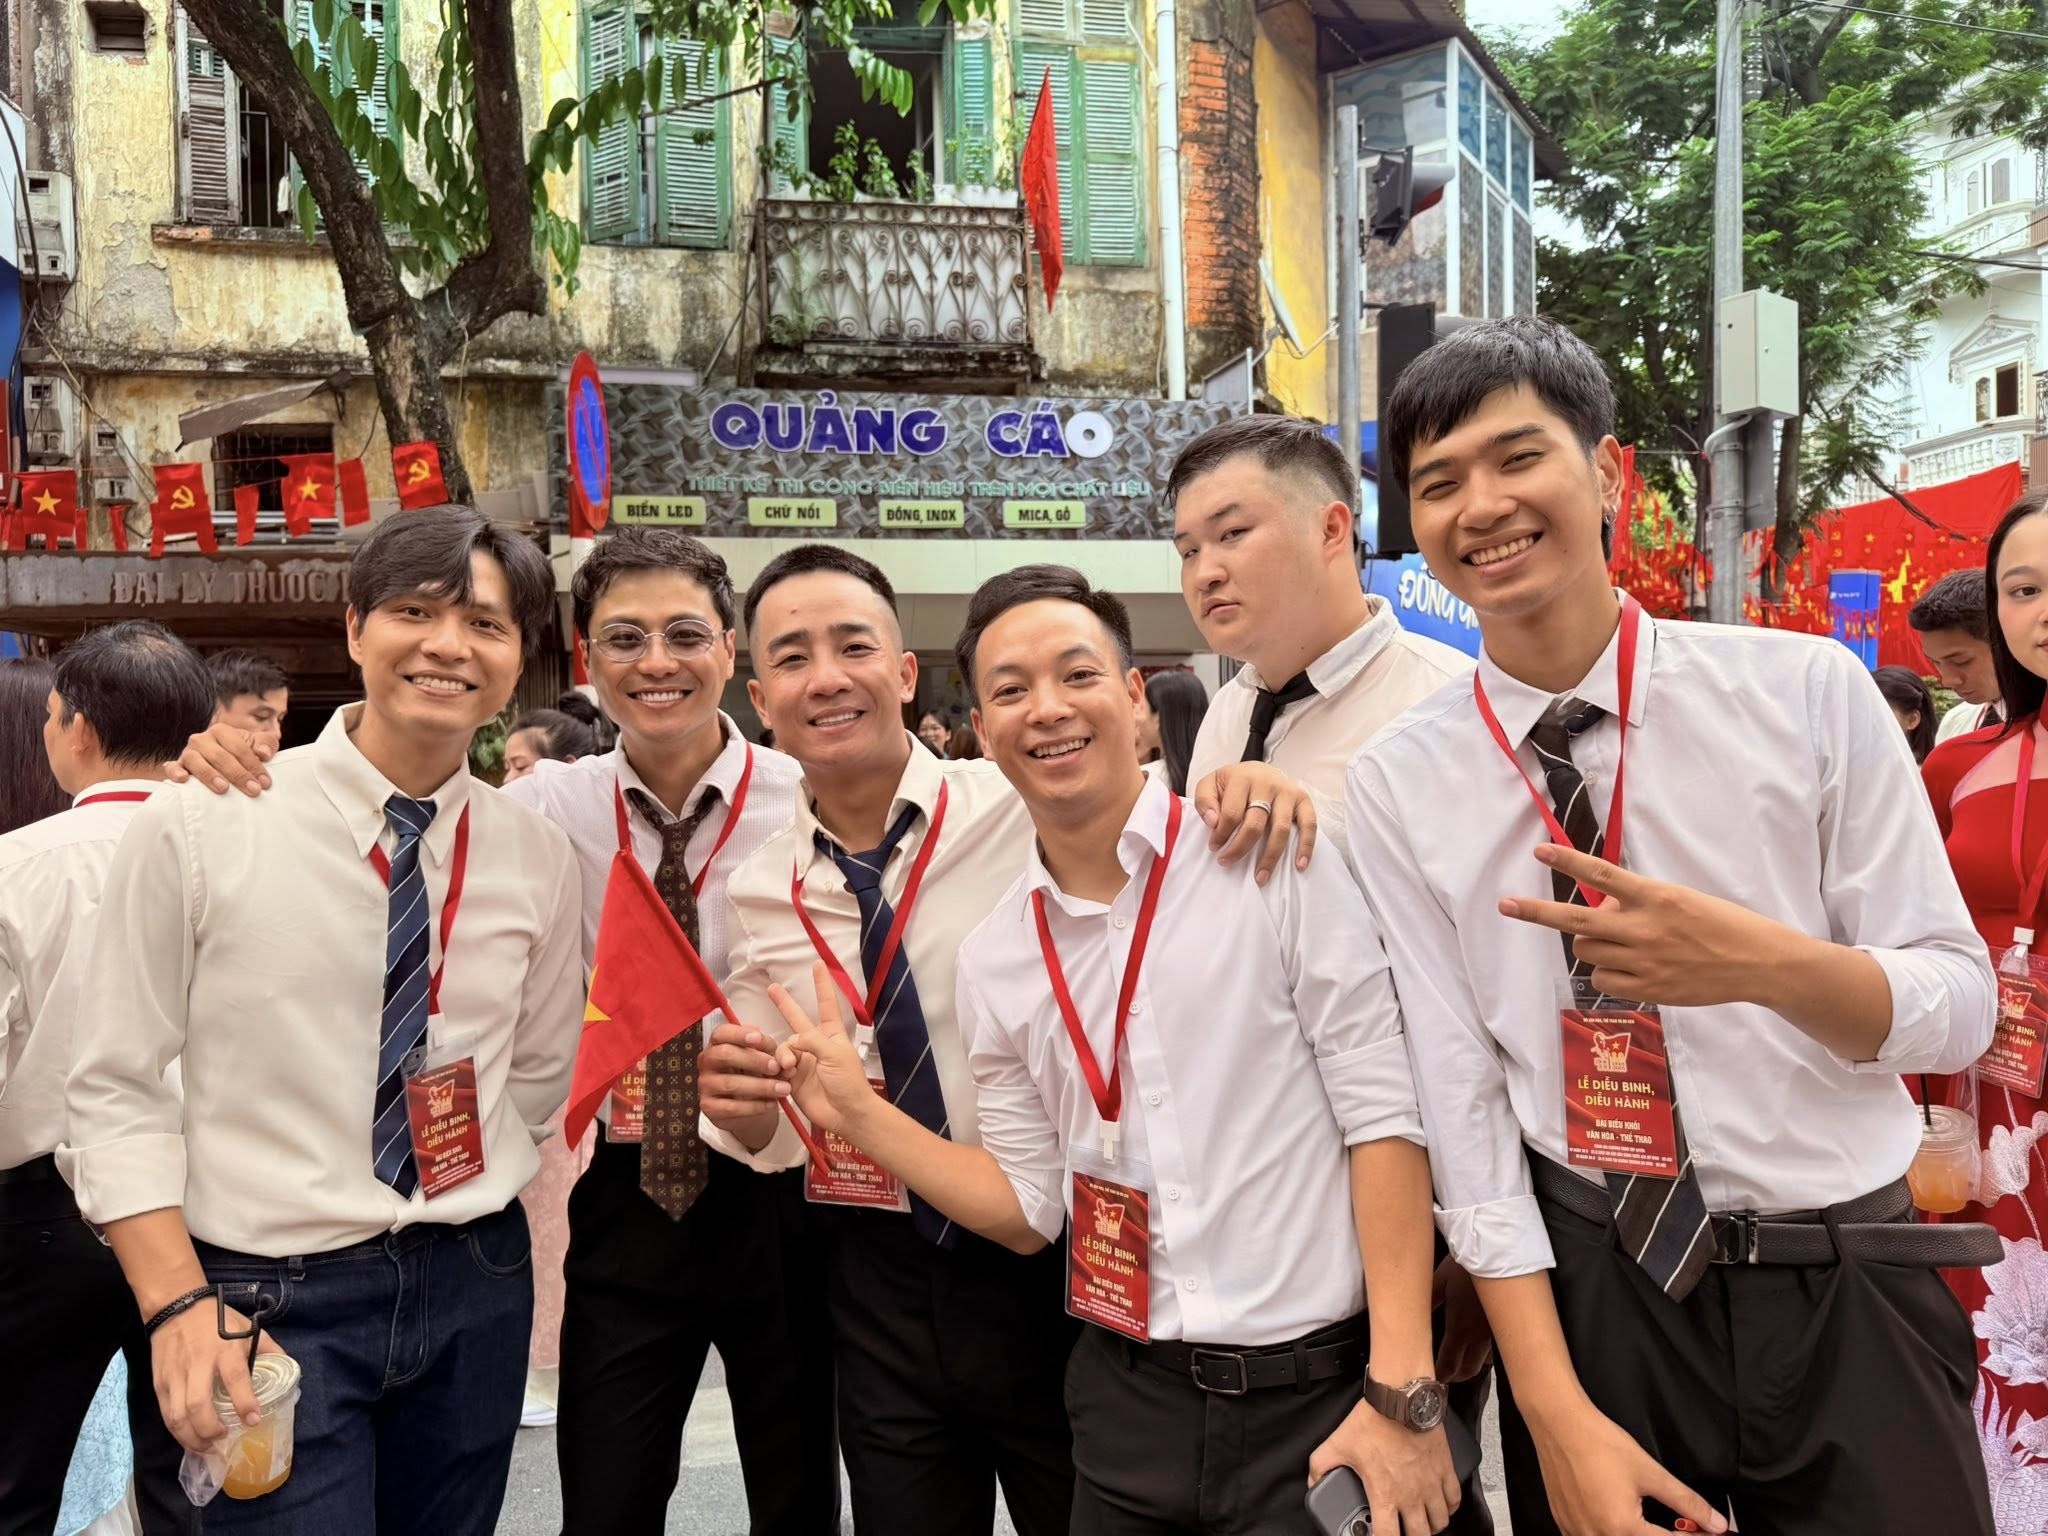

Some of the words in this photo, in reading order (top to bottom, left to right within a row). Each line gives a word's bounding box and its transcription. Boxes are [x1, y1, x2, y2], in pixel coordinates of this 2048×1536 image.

[711, 390, 948, 456] QUẢNG
[984, 400, 1114, 459] CÁO
[775, 478, 804, 493] THI
[809, 476, 873, 495] CÔNG
[923, 479, 965, 498] HIỆU
[968, 479, 1014, 497] TRÊN
[667, 505, 693, 518] LED
[926, 509, 956, 521] INOX
[1018, 509, 1053, 523] MICA,
[112, 571, 166, 607] ĐẠI
[1578, 1075, 1589, 1089] LỄ
[1592, 1076, 1618, 1091] DIỄU
[1622, 1081, 1655, 1096] BINH,
[1585, 1092, 1611, 1106] DIỄU
[1615, 1096, 1650, 1110] HÀNH
[1082, 1234, 1091, 1247] LỄ
[1092, 1239, 1112, 1254] DIỄU
[1114, 1247, 1138, 1266] BINH,
[1086, 1251, 1105, 1266] DIỄU
[1108, 1260, 1133, 1277] HÀNH
